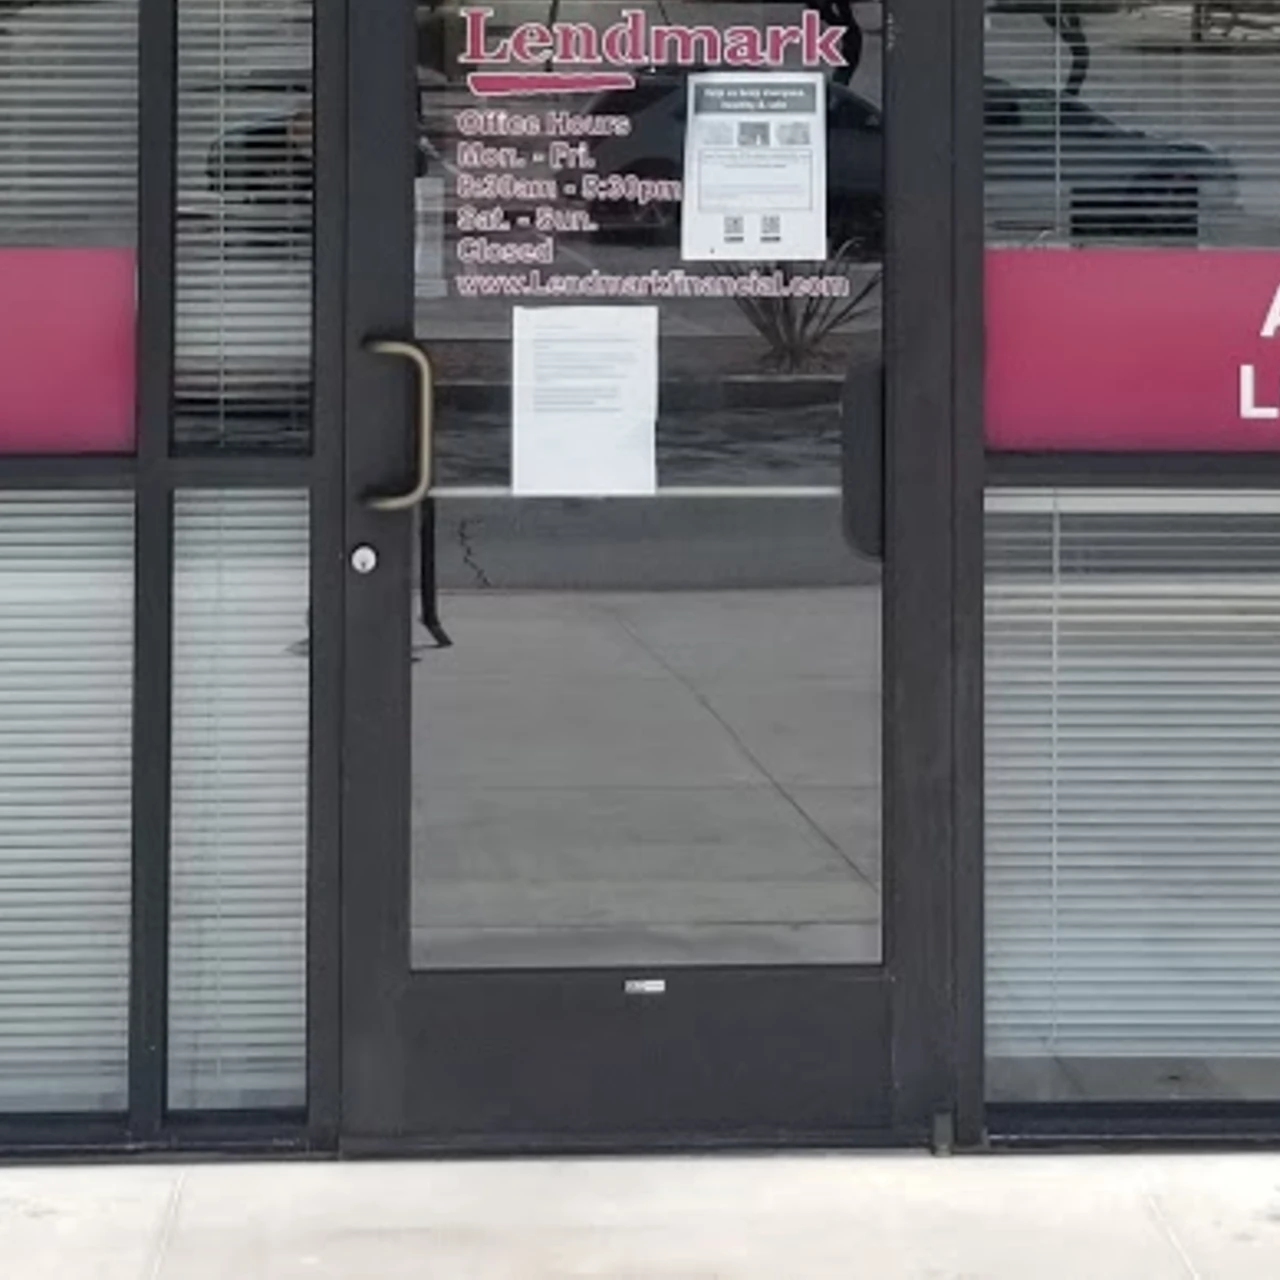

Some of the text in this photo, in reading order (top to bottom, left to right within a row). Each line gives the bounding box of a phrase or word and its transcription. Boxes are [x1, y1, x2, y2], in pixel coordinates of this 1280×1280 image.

[458, 6, 849, 67] Lendmark
[455, 109, 632, 136] Office Hours
[457, 141, 526, 168] Mon.
[456, 204, 511, 231] Sat.
[535, 206, 600, 231] Sun.
[456, 236, 554, 264] Closed
